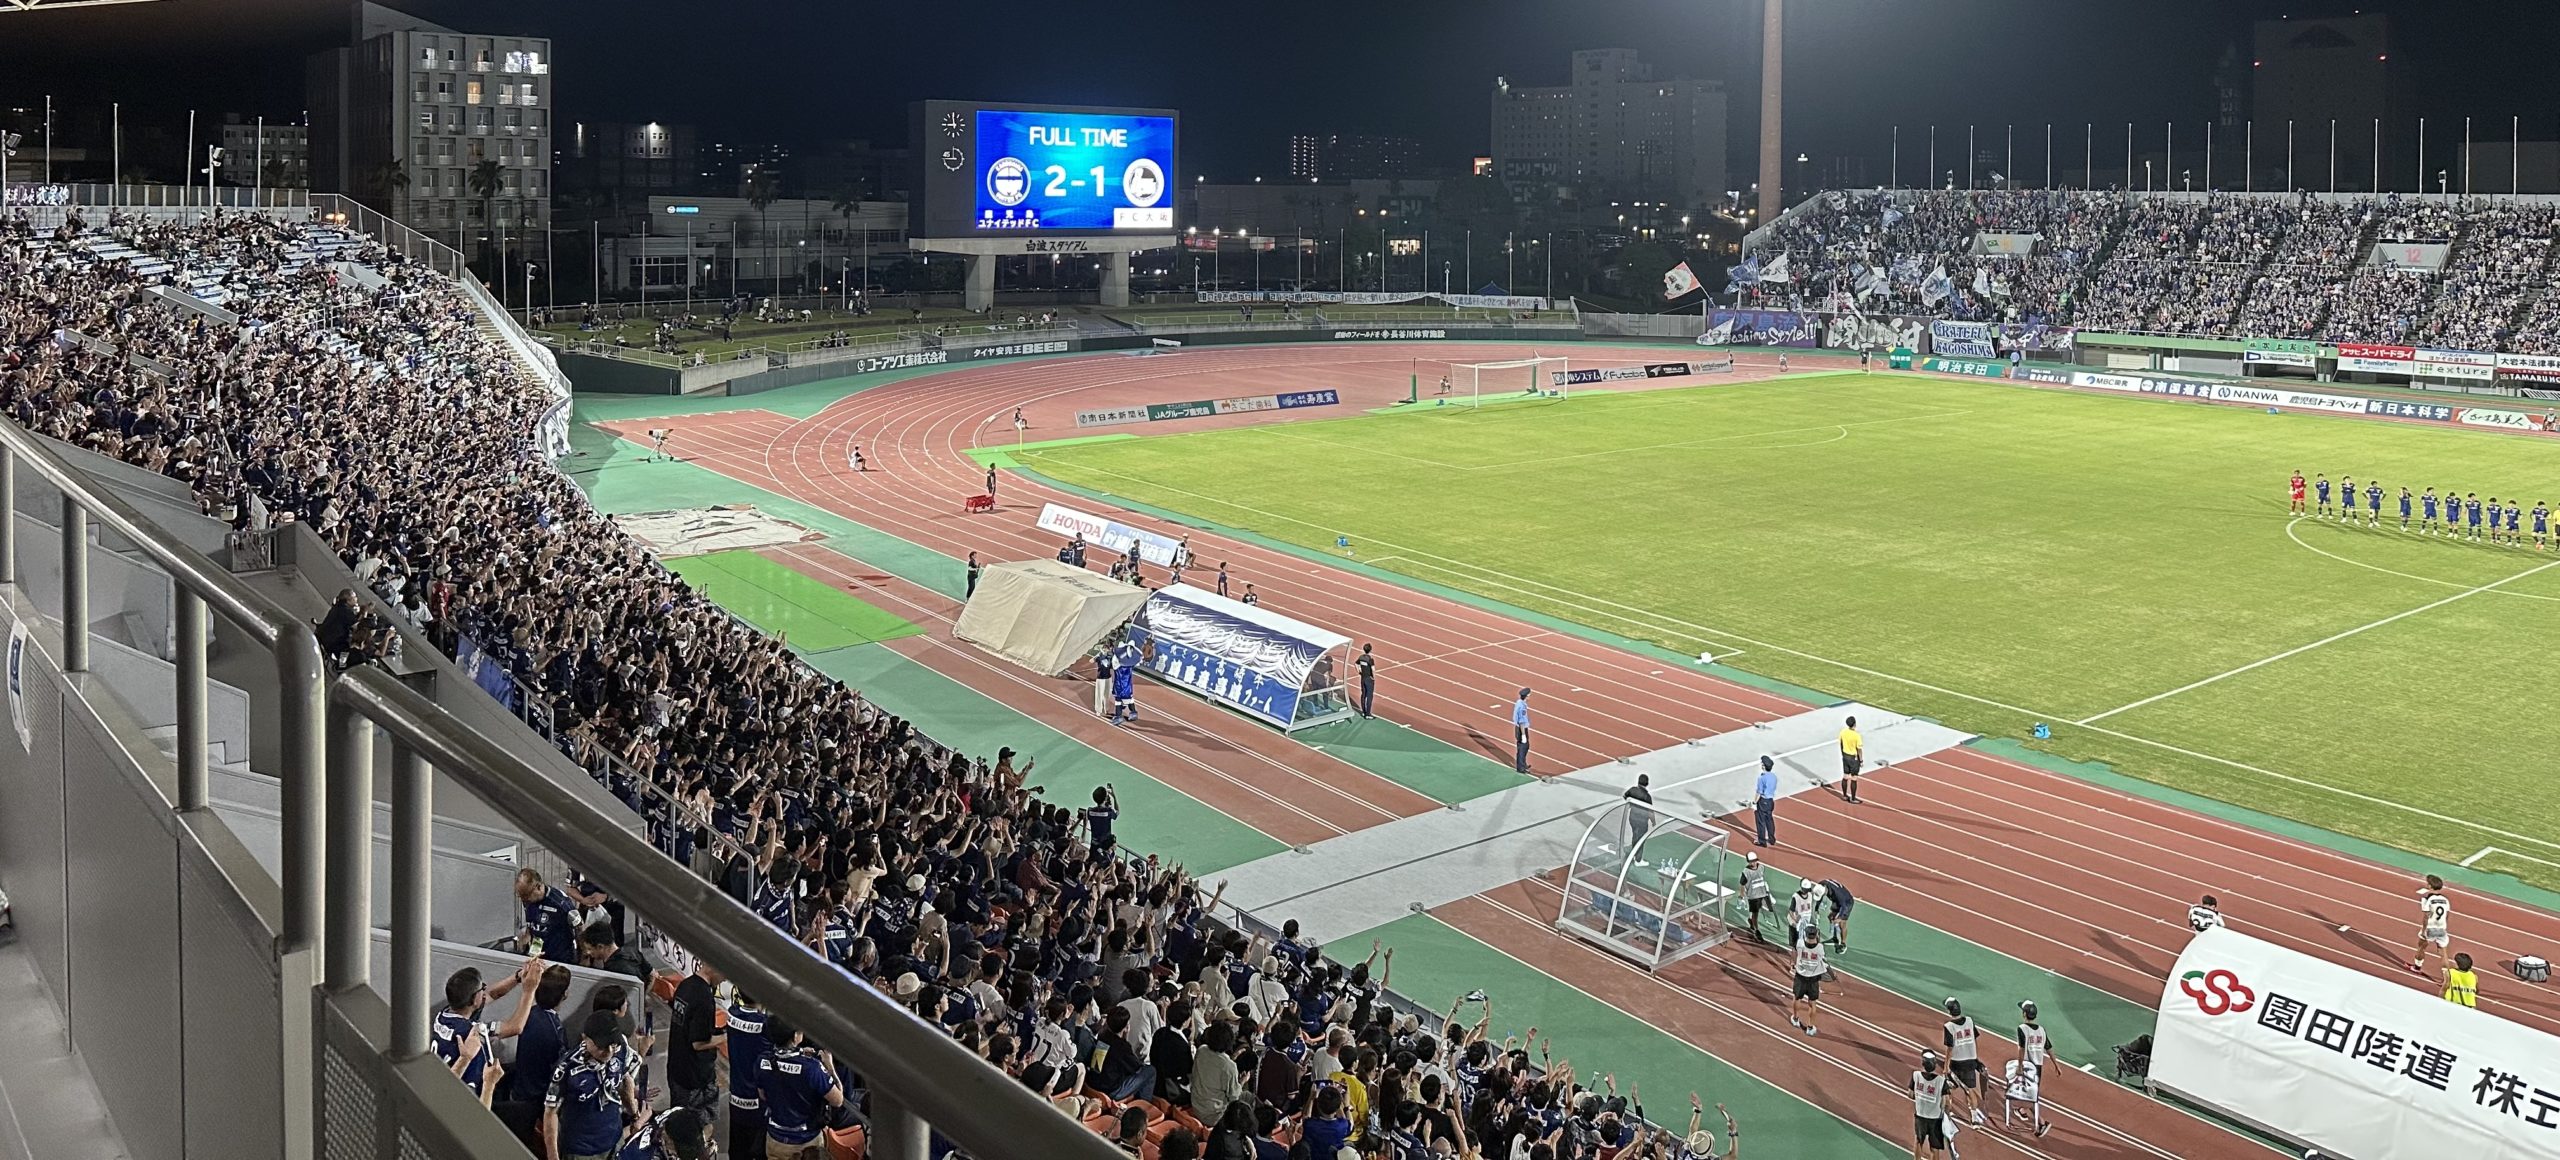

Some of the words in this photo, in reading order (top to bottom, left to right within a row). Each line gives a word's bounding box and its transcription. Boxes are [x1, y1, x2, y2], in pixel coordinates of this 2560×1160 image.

[1029, 126, 1077, 147] FULL
[1081, 127, 1128, 148] TIME
[1044, 164, 1106, 197] 2-1
[1026, 239, 1088, 252] 白波スタジアム
[2405, 248, 2422, 262] 12
[1935, 340, 1994, 358] KAGOSHIMA
[867, 350, 948, 372] コーアツ工業株式会社
[1938, 360, 1988, 376] 明治安田
[2363, 359, 2398, 367] FamilyMart
[2436, 366, 2488, 376] exture
[2233, 390, 2279, 402] NANWA
[2289, 395, 2365, 410] 鹿児島トヨペット
[1088, 409, 1146, 423] 南日本新聞社
[1154, 406, 1210, 418] JAグループ鹿児島
[2368, 401, 2449, 418] 新日本科学
[1053, 513, 1101, 538] HONDA
[2435, 906, 2445, 921] 9
[2257, 992, 2458, 1092] 園田陸運
